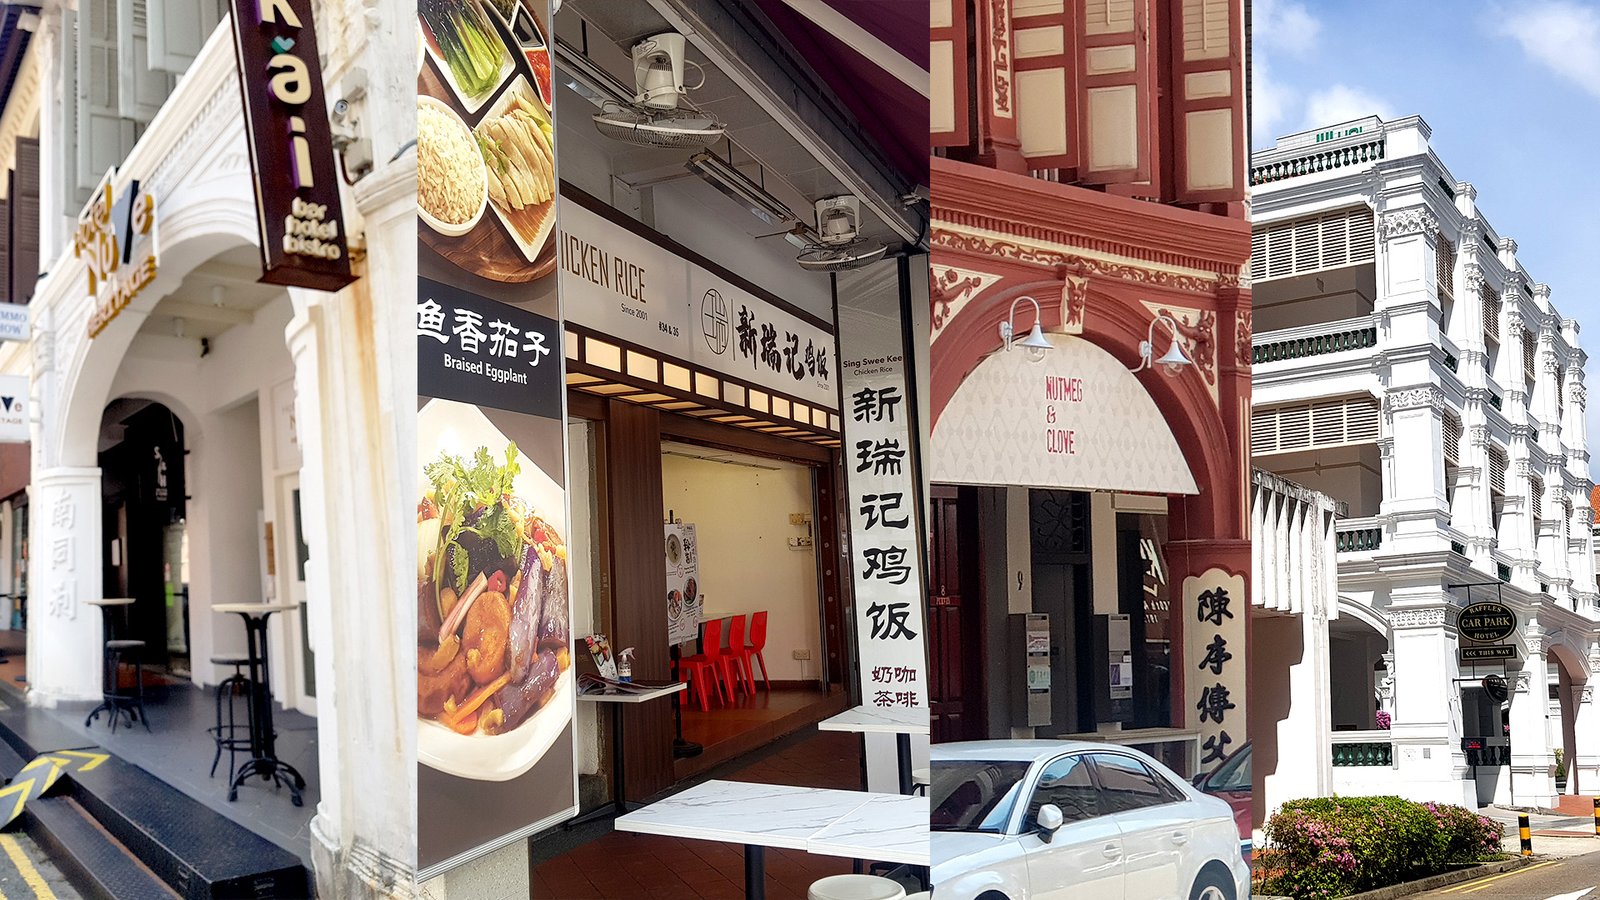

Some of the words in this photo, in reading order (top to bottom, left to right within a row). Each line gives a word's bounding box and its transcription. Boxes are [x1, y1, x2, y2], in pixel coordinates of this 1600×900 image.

[292, 196, 328, 220] bar
[285, 214, 338, 240] hotel
[282, 234, 341, 260] bistro
[614, 256, 647, 303] RICE
[620, 303, 635, 317] Since
[635, 308, 648, 321] 2001
[417, 298, 550, 367] 鱼香茄子
[443, 353, 483, 375] Braised
[485, 362, 528, 385] Eggplant
[843, 360, 861, 369] Sing
[863, 357, 885, 366] Swee
[886, 355, 903, 363] Kee
[853, 368, 879, 377] Chicken
[1045, 376, 1083, 402] NUTMEG
[1046, 404, 1057, 424] &
[1046, 429, 1075, 455] CLOVE
[852, 386, 918, 641] 新瑞记鸡饭
[1461, 618, 1482, 628] CAR
[1483, 616, 1510, 627] PARK
[1468, 605, 1502, 614] RAFFLES
[1474, 632, 1500, 640] HOTEL
